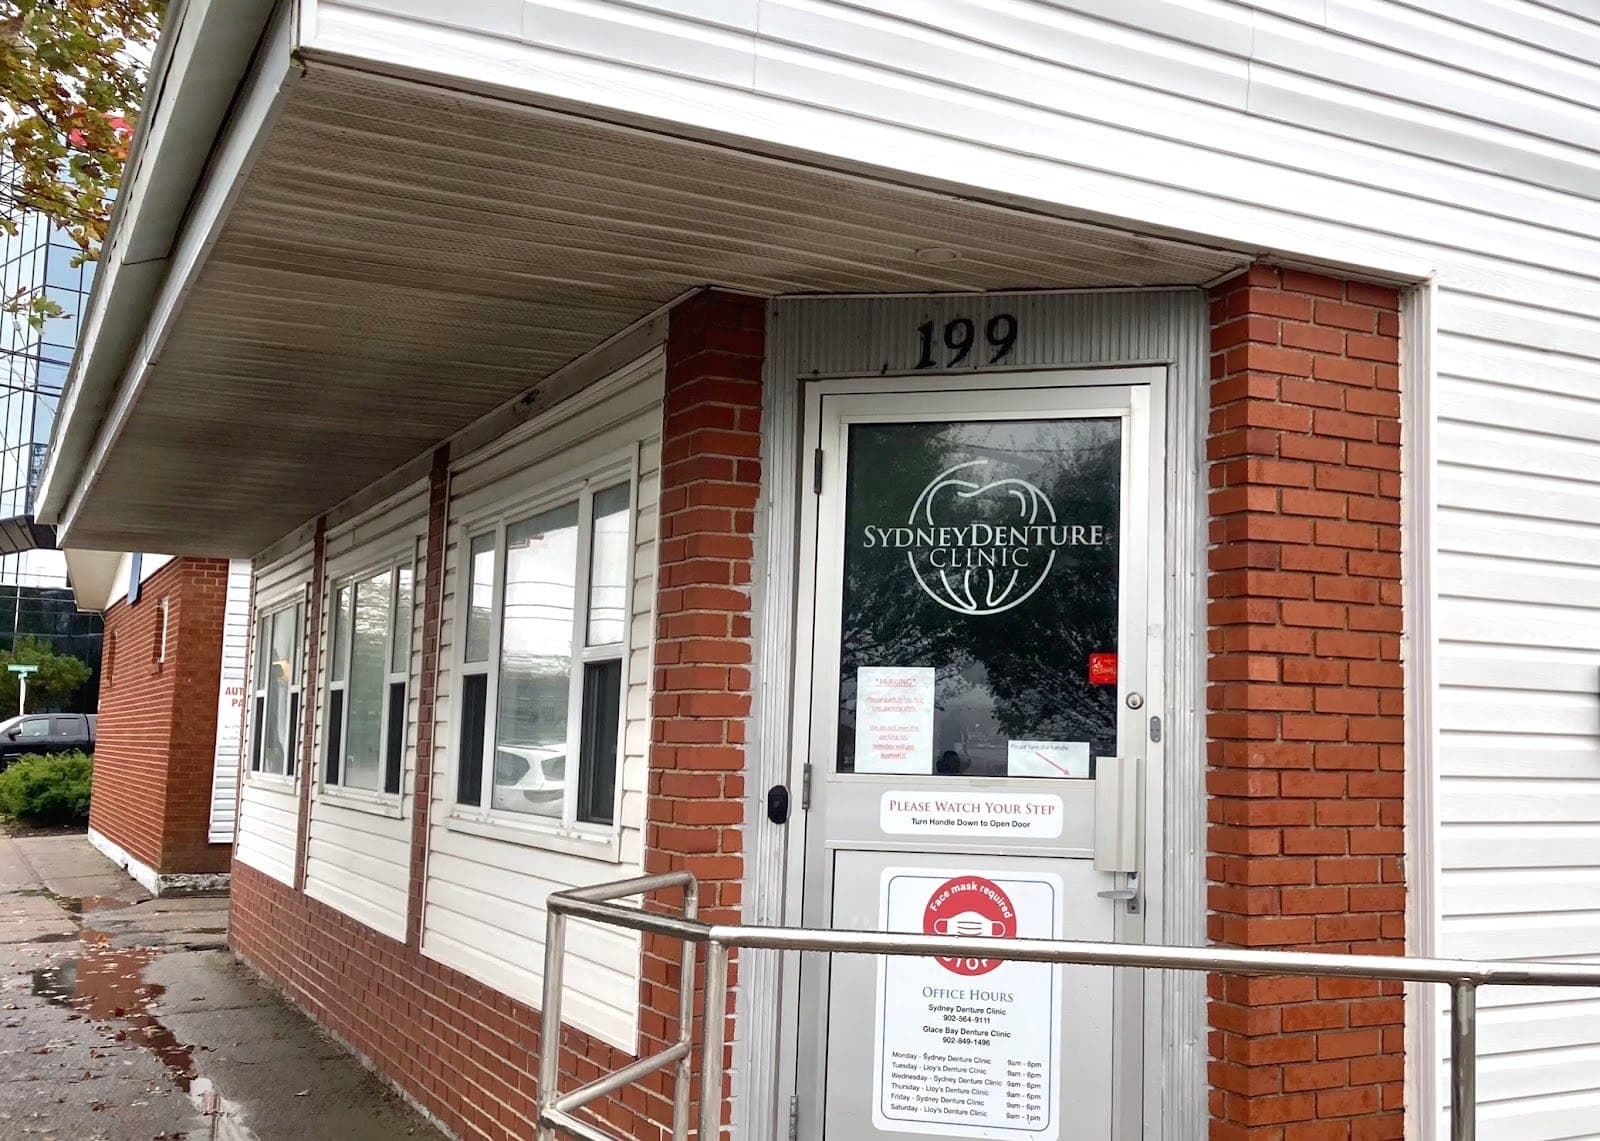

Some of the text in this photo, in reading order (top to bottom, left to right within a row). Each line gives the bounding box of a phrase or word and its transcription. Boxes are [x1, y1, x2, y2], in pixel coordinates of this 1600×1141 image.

[914, 314, 1017, 369] 199
[929, 548, 1030, 568] CLINIC
[889, 800, 1055, 815] PLEASE WATCH YOUR STEP
[912, 818, 928, 826] Turn
[929, 818, 956, 826] Handle
[957, 819, 979, 827] Down
[989, 820, 1010, 829] Open
[929, 881, 1014, 919] Face mask required
[922, 986, 1014, 1003] OFFICE HOURS
[928, 1004, 1007, 1016] Sydney Denture Clinic
[943, 1014, 991, 1024] 902-564-9111
[922, 1025, 1011, 1038] Glace Bay Denture Clinic
[892, 1051, 917, 1060] Monday
[923, 1052, 946, 1062] Sydney
[947, 1055, 973, 1063] Denture
[973, 1056, 992, 1065] Clinic
[892, 1061, 917, 1070] Tuesday
[942, 1065, 967, 1073] Denture
[968, 1067, 987, 1075] Clinic
[891, 1072, 928, 1081] Wednesday
[933, 1075, 957, 1084] Sydney
[958, 1076, 983, 1085] Denture
[984, 1079, 1003, 1087] Clinic
[891, 1082, 920, 1091] Thursday
[945, 1086, 970, 1095] Denture
[971, 1088, 990, 1096] Clinic
[890, 1093, 910, 1102] Friday
[916, 1095, 939, 1104] Sydney
[940, 1096, 966, 1105] Denture
[966, 1098, 985, 1106] Clinic
[890, 1103, 918, 1113] Saturday
[943, 1107, 969, 1116] Denture
[969, 1109, 988, 1117] Clinic
